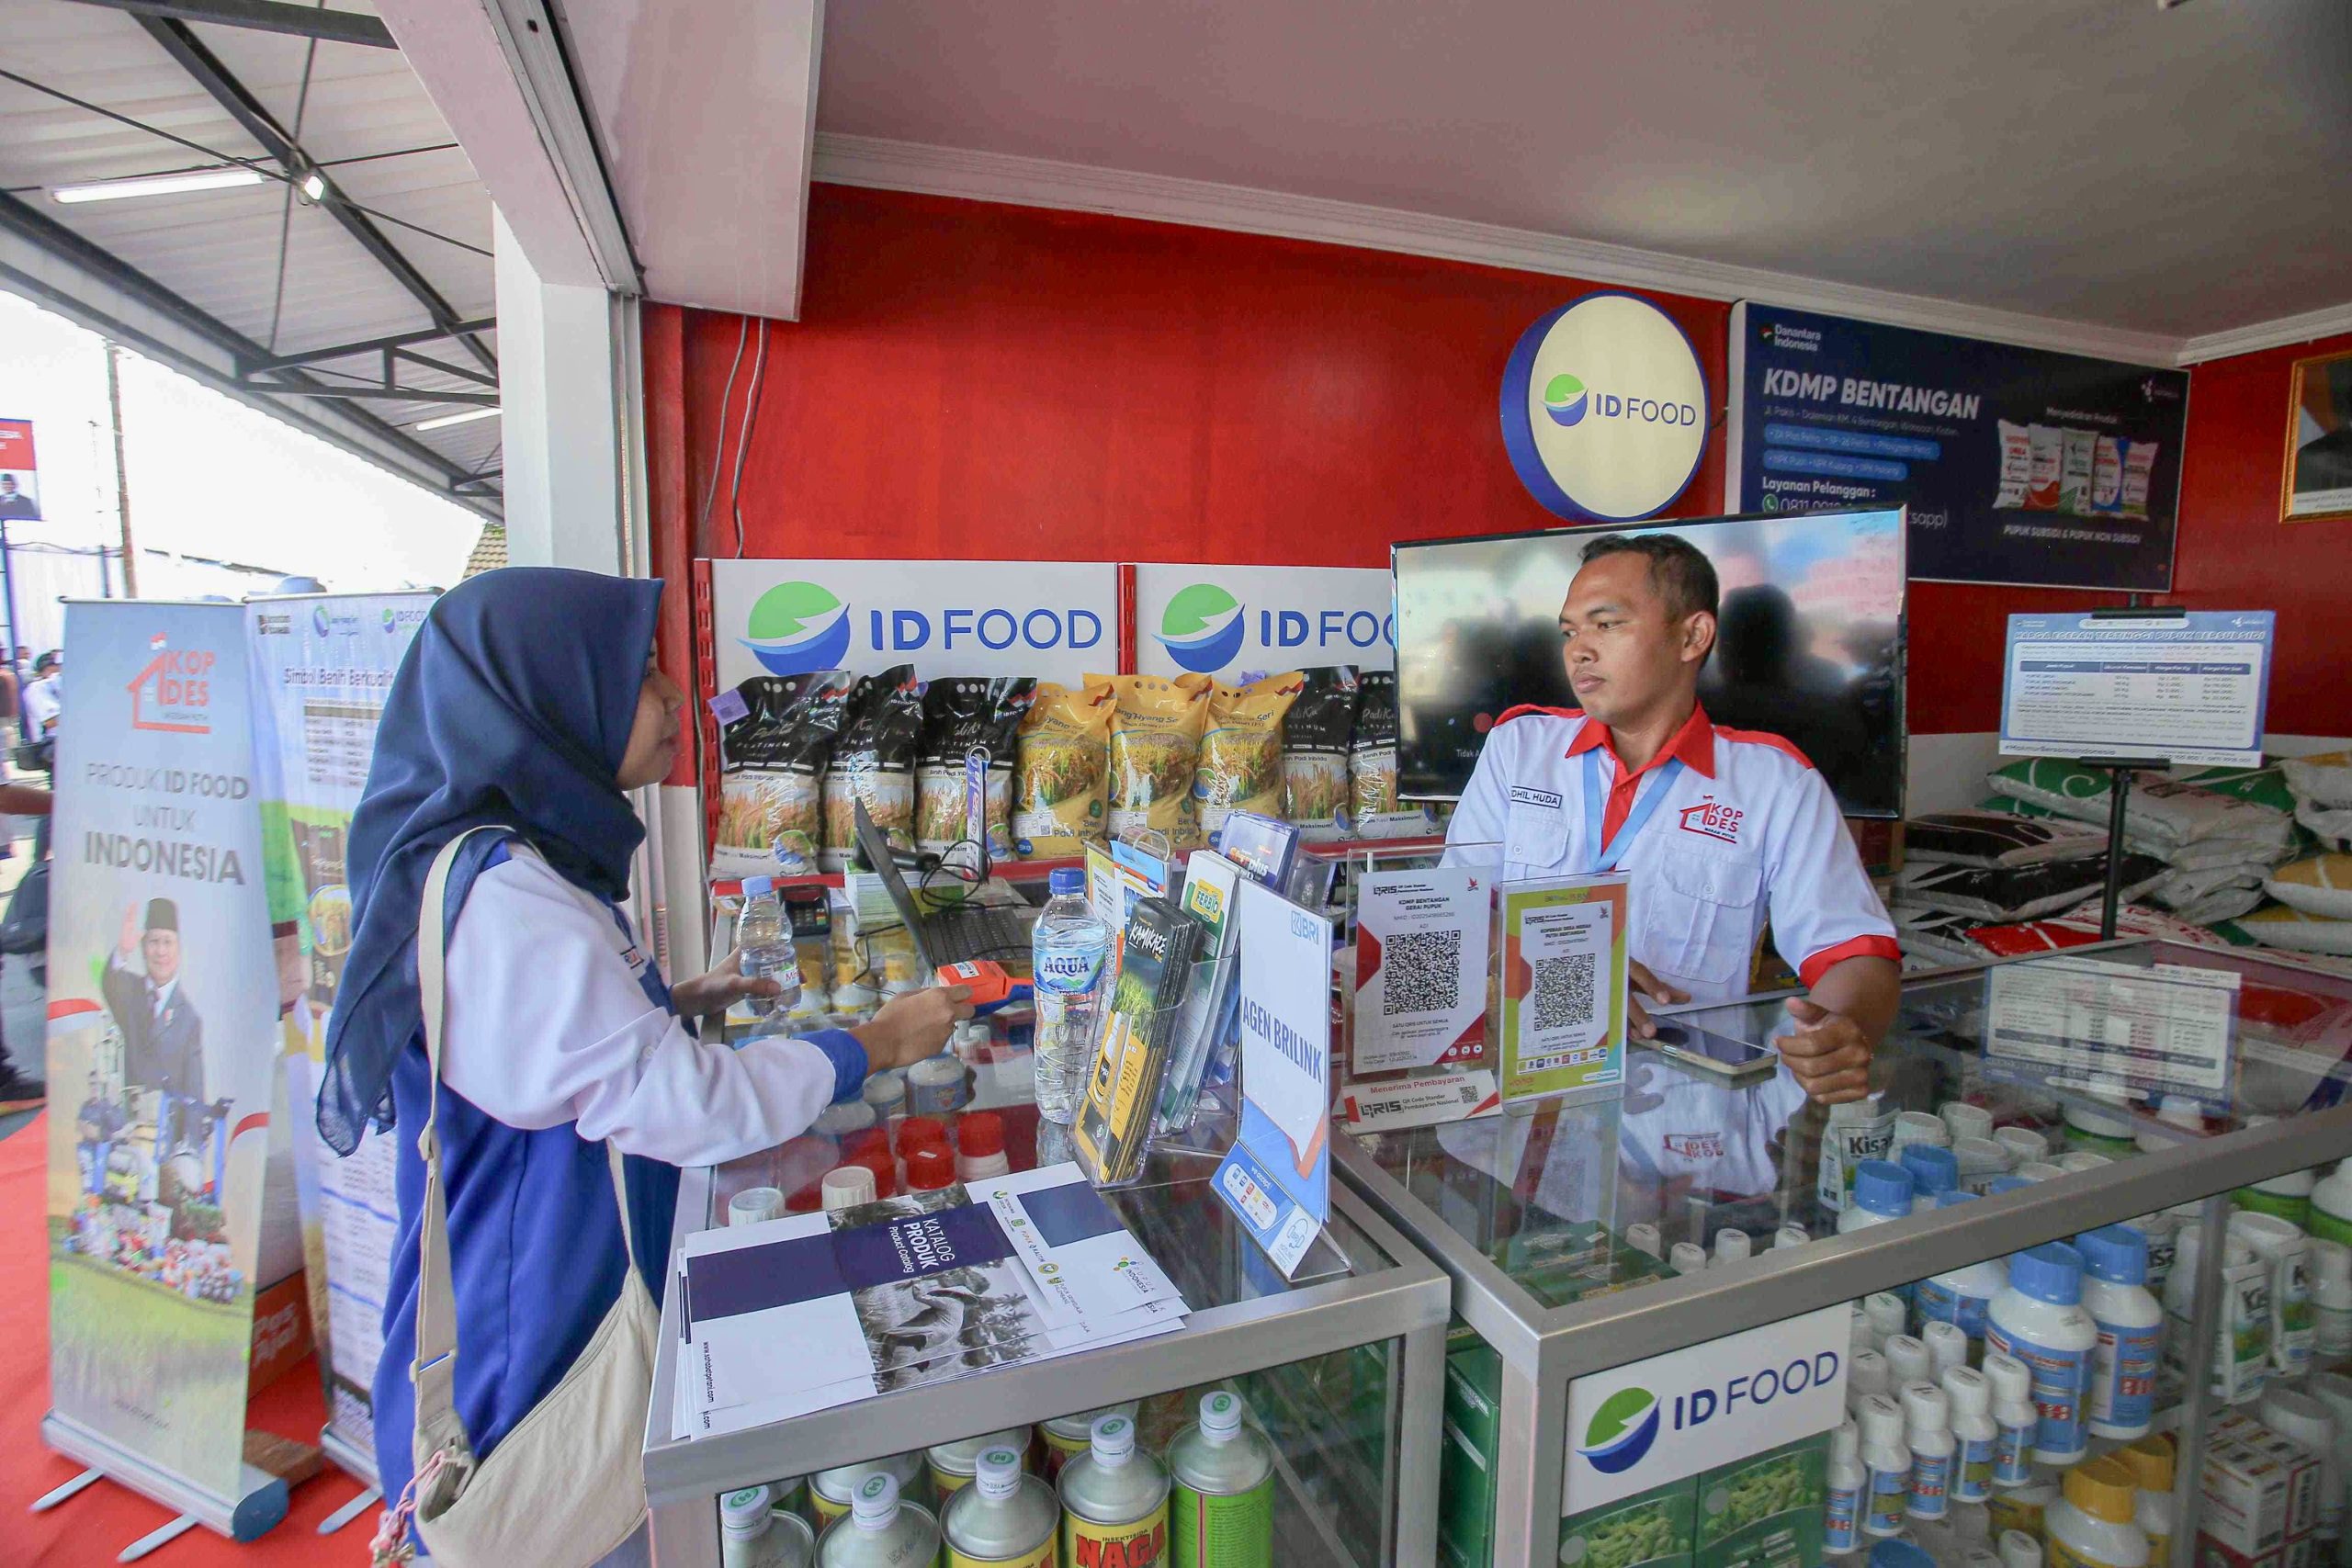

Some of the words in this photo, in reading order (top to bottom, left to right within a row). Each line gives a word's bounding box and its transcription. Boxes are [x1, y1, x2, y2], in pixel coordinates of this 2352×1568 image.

[1775, 324, 1821, 341] Danantara
[1774, 337, 1818, 352] Indonesia
[1763, 368, 1837, 401] KDMP
[1840, 378, 1980, 420] BENTANGAN
[1596, 393, 1622, 417] ID
[1626, 398, 1696, 426] FOOD
[1763, 476, 1810, 492] Layanan
[1813, 480, 1870, 500] Pelanggan
[1908, 509, 1948, 529] sapp)
[871, 609, 931, 650] ID
[944, 609, 1102, 649] FOOD
[1261, 610, 1309, 648] ID
[165, 649, 215, 675] KOP
[349, 669, 395, 688] Berkualit
[165, 680, 209, 707] DES
[1134, 714, 1164, 724] Hyang
[1257, 710, 1274, 722] Seri
[86, 762, 162, 791] PRODUK
[165, 770, 184, 794] ID
[189, 772, 250, 799] FOOD
[1532, 793, 1558, 805] HUDA
[134, 805, 197, 831] UNTUK
[1389, 814, 1421, 822] Maksimum!
[1712, 803, 1744, 819] KOP
[1707, 815, 1739, 833] DES
[85, 830, 245, 886] INDONESIA
[1017, 843, 1032, 852] 5kg
[1196, 891, 1219, 914] FERBIO
[1373, 886, 1397, 897] QRIS
[1416, 897, 1450, 905] BENTANGAN
[1129, 920, 1167, 954] KAMIKAZE
[1302, 917, 1319, 945] BRI
[1044, 956, 1090, 976] AQUA
[1242, 996, 1271, 1043] AGEN
[1273, 1015, 1323, 1084] BRILINK
[1370, 1081, 1412, 1094] Menerima
[1413, 1076, 1465, 1089] Pembayaran
[1360, 1100, 1404, 1119] QRIS
[1404, 1100, 1436, 1111] Pembayaran
[1436, 1098, 1459, 1107] Nasional
[888, 1226, 906, 1250] Product
[898, 1249, 914, 1273] Catalog
[903, 1222, 939, 1269] PRODUK
[922, 1218, 956, 1262] KATALOG
[1125, 1268, 1148, 1293] INDONESIA
[1674, 1388, 1717, 1430] ID
[1726, 1351, 1838, 1415] FOOD
[1102, 1529, 1148, 1542] INSEKTISIDA
